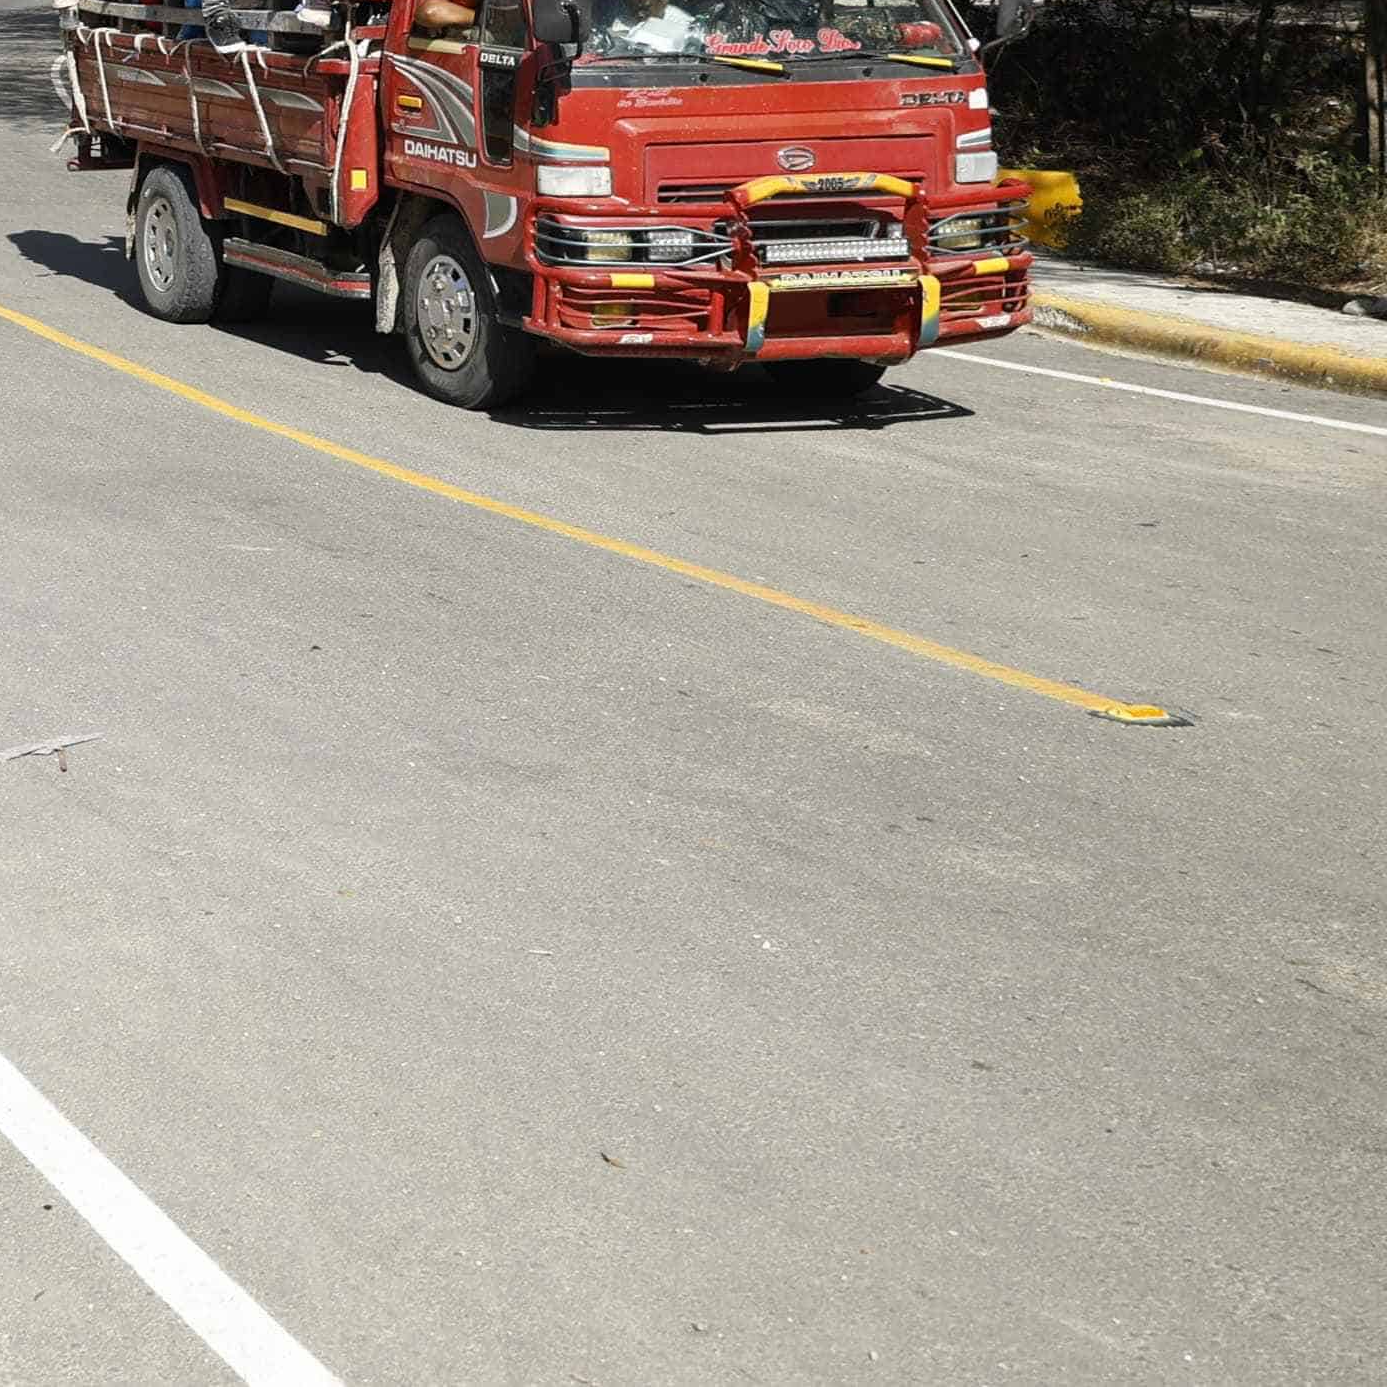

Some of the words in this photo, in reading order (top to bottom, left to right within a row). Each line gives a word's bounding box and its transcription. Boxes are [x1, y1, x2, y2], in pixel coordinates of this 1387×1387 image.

[480, 52, 515, 66] DELTA
[404, 139, 477, 168] DAIHATSU
[818, 177, 844, 191] 2005
